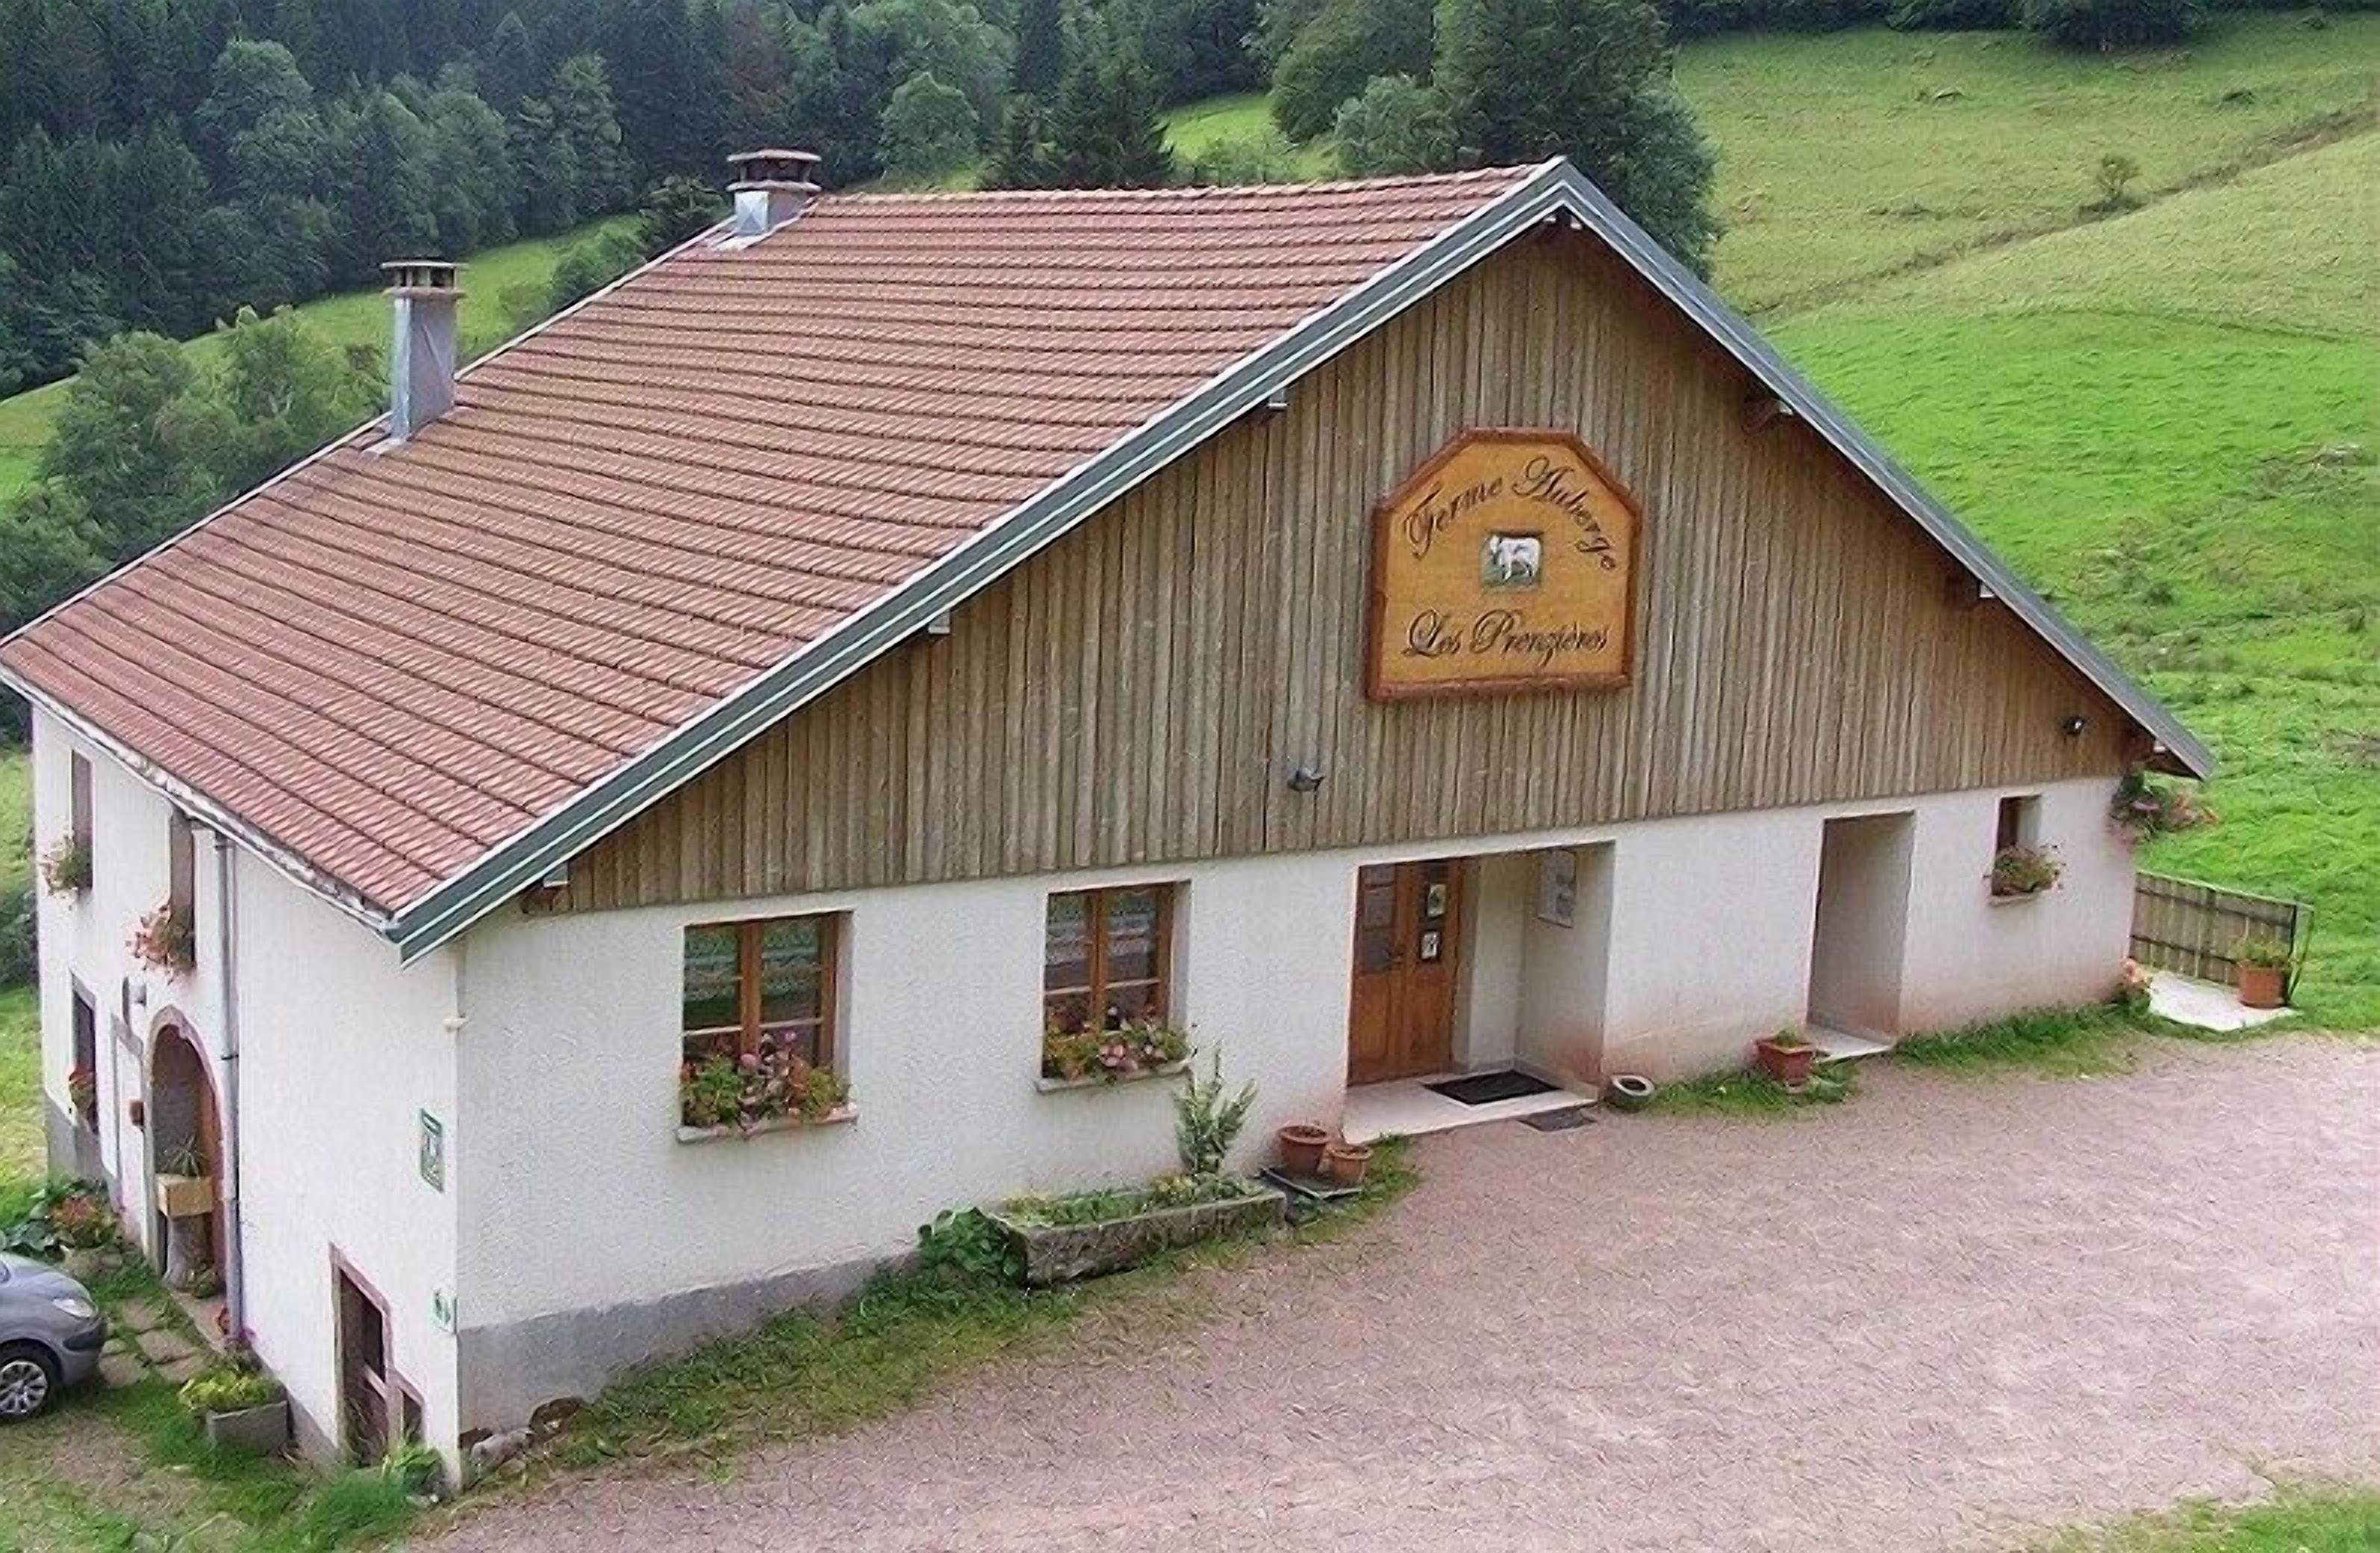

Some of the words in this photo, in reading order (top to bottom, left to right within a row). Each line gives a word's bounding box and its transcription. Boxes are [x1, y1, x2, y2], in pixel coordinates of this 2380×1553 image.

[1404, 478, 1503, 558] Ferme
[1513, 455, 1616, 571] Auberge
[1403, 609, 1463, 658] Les
